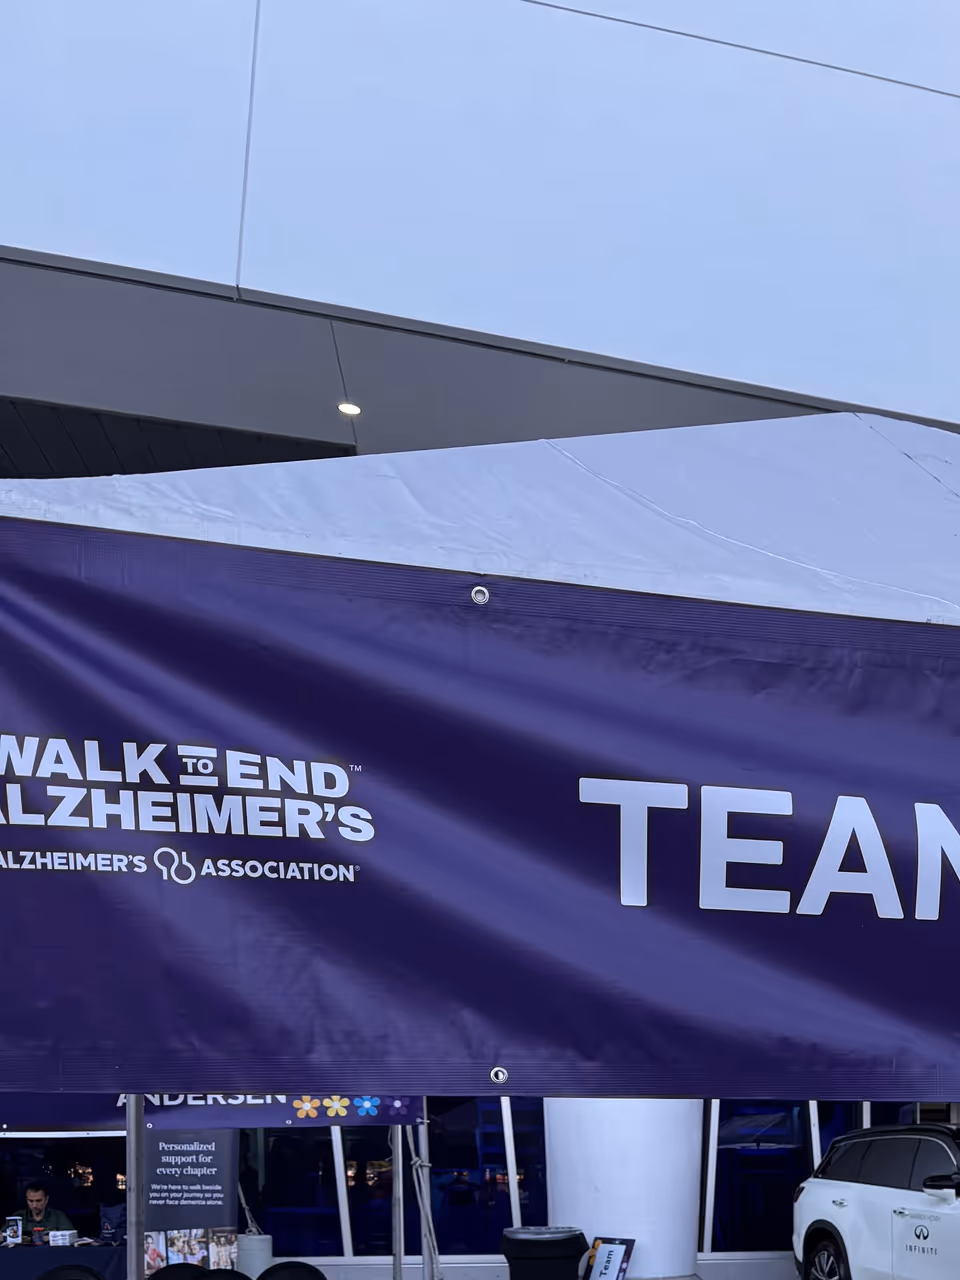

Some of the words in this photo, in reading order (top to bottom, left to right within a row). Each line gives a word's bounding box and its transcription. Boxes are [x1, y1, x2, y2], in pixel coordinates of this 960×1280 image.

[182, 756, 214, 774] TO
[225, 749, 350, 799] END
[158, 1141, 216, 1151] Personalized
[161, 1154, 196, 1165] support
[198, 1154, 213, 1163] for
[156, 1167, 181, 1178] every
[183, 1165, 218, 1177] chapter
[600, 1250, 615, 1277] Team
